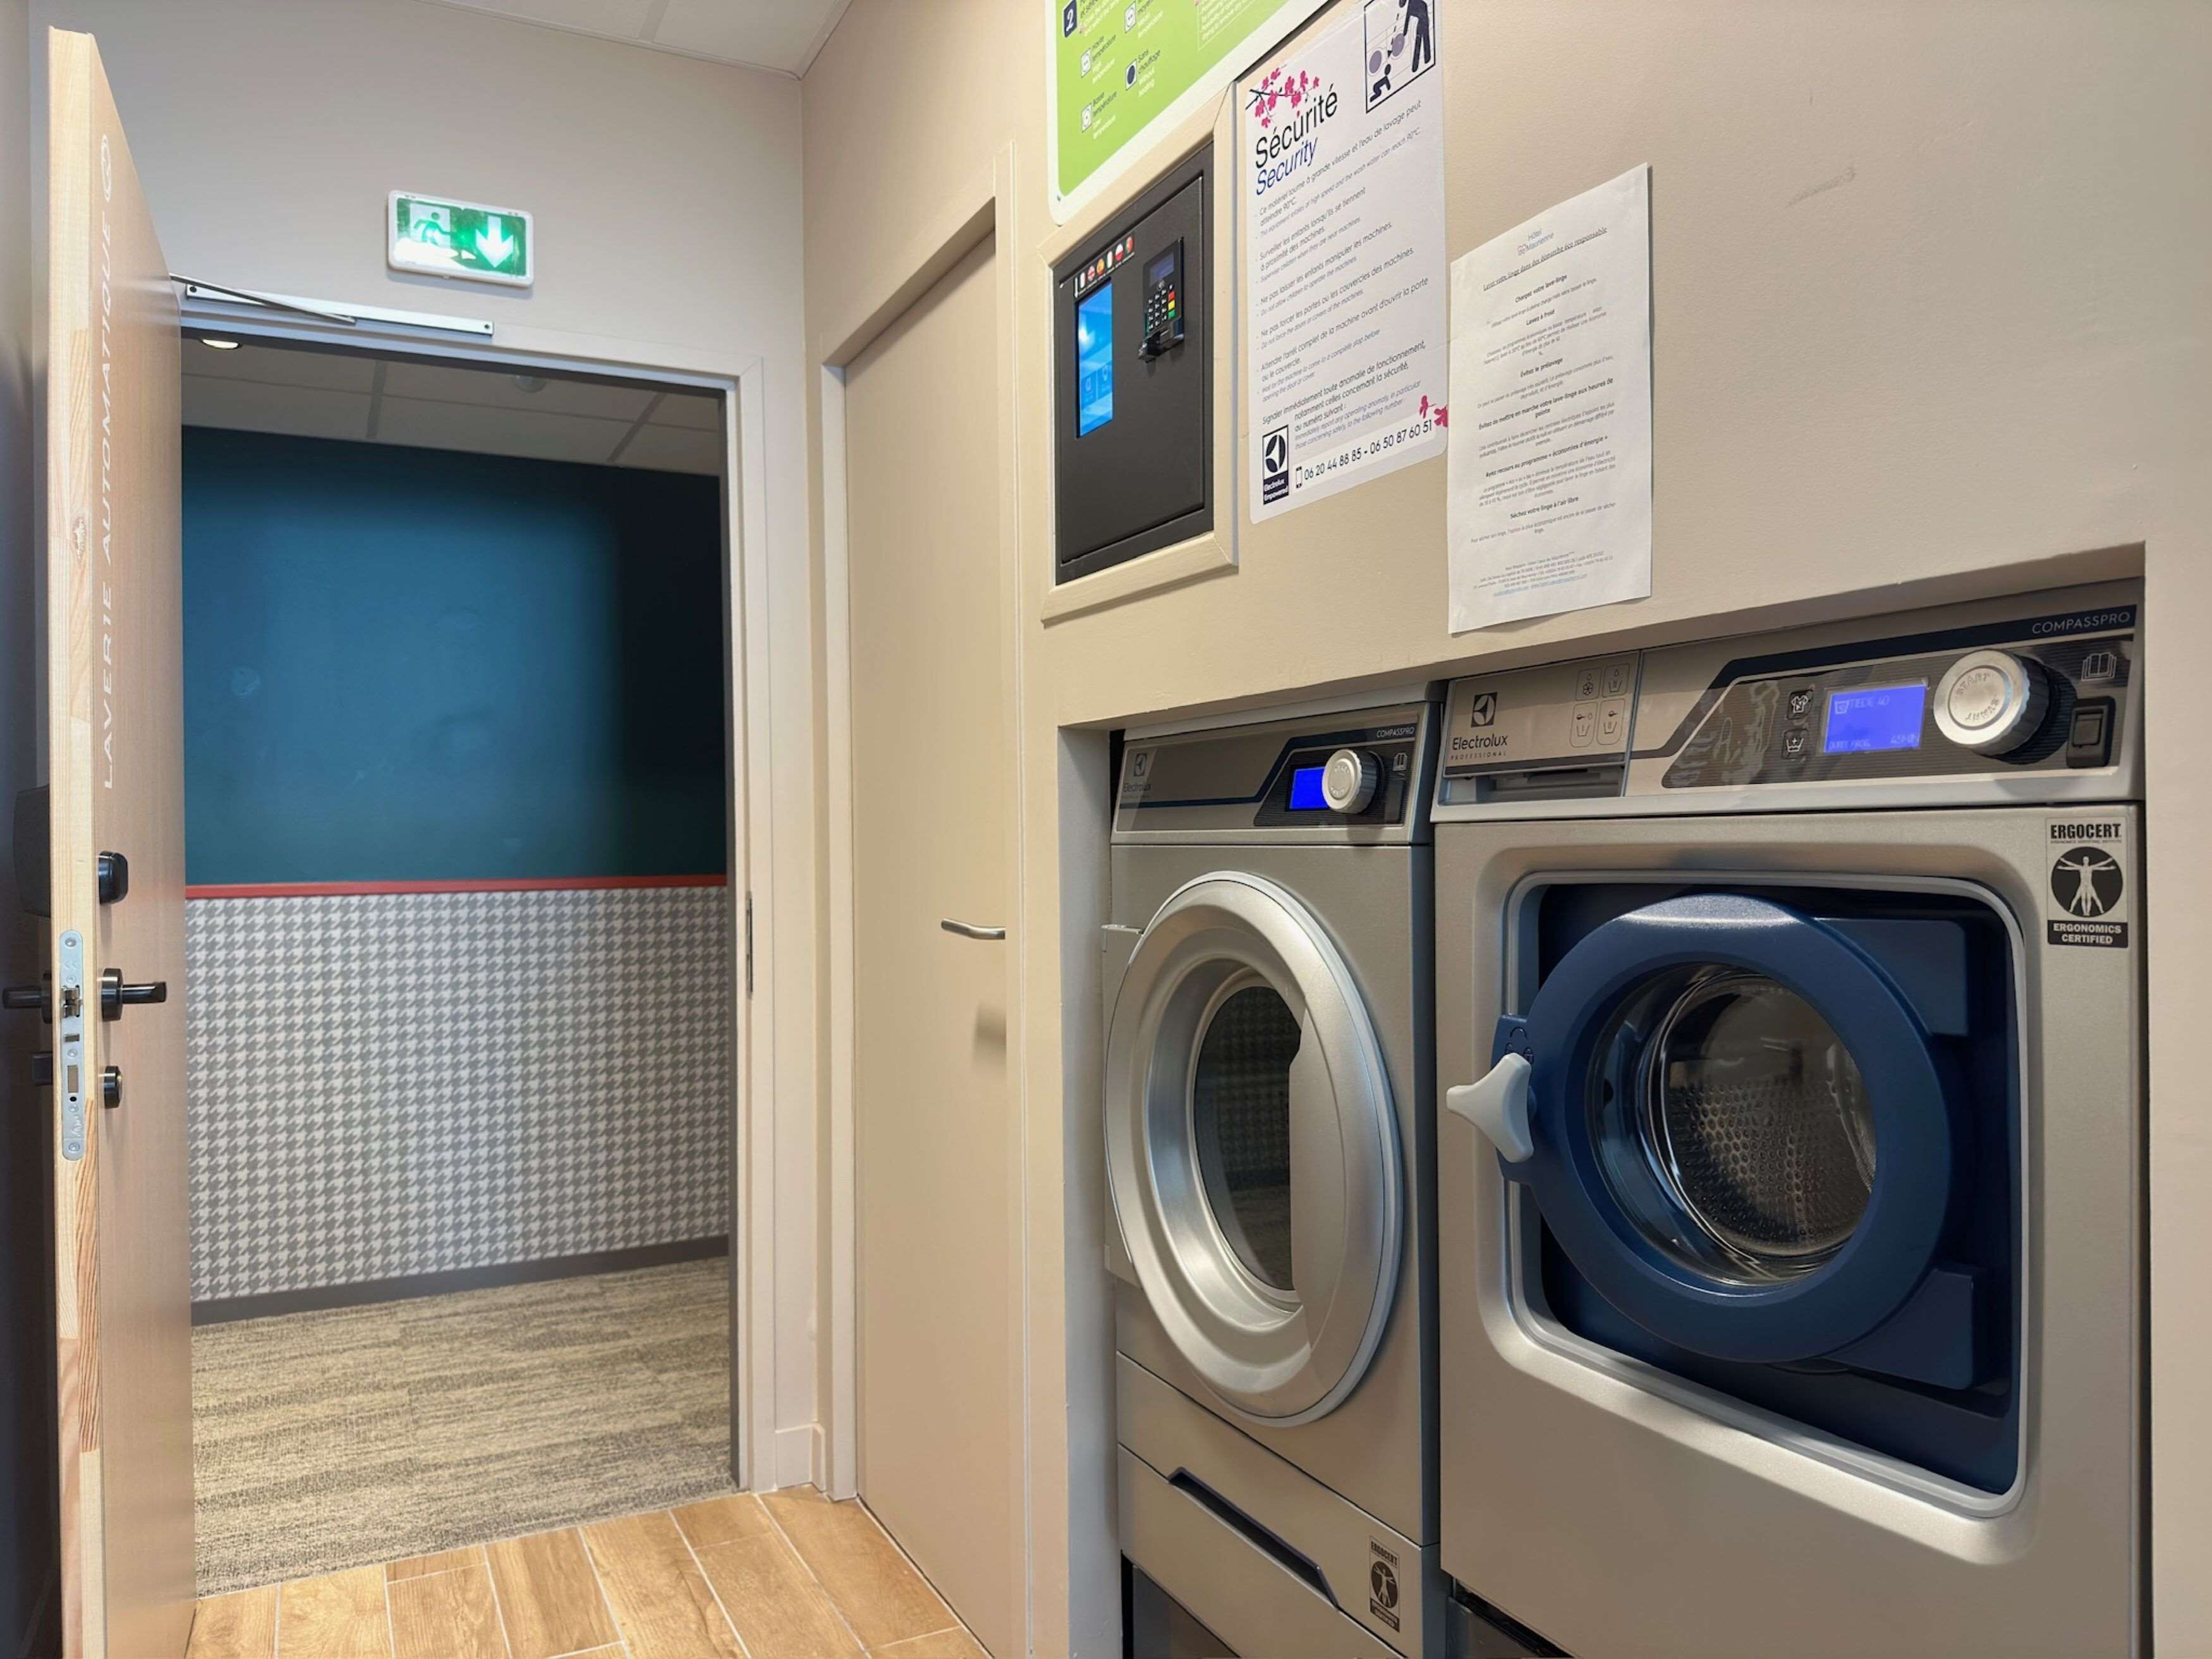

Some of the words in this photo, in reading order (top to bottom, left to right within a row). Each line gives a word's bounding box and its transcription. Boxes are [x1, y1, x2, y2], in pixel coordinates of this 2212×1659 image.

[1066, 9, 1074, 32] 2
[1256, 83, 1338, 169] Sécurité
[1256, 137, 1318, 195] Security
[102, 212, 111, 566] AUTOMATIQUE
[1535, 408, 1550, 418] pointe
[1304, 468, 1313, 480] 06
[1316, 463, 1325, 477] 20
[1327, 459, 1337, 470] 44
[1340, 453, 1349, 466] 88
[1352, 447, 1361, 462] 85
[1370, 440, 1380, 454] 06
[1383, 434, 1394, 449] 50
[1397, 429, 1406, 444] 87
[1409, 423, 1420, 439] 60
[1423, 419, 1431, 434] 51
[2032, 611, 2130, 634] COMPASSPRO
[103, 581, 112, 789] LAVERIE
[1376, 727, 1415, 738] COMPASSPRO
[1452, 733, 1509, 750] Electrolux
[1450, 751, 1507, 760] PROFESSIONAL
[2050, 823, 2122, 840] ERGOCERT
[2053, 923, 2122, 933] ERGONOMICS
[2062, 934, 2113, 944] CERTIFIED
